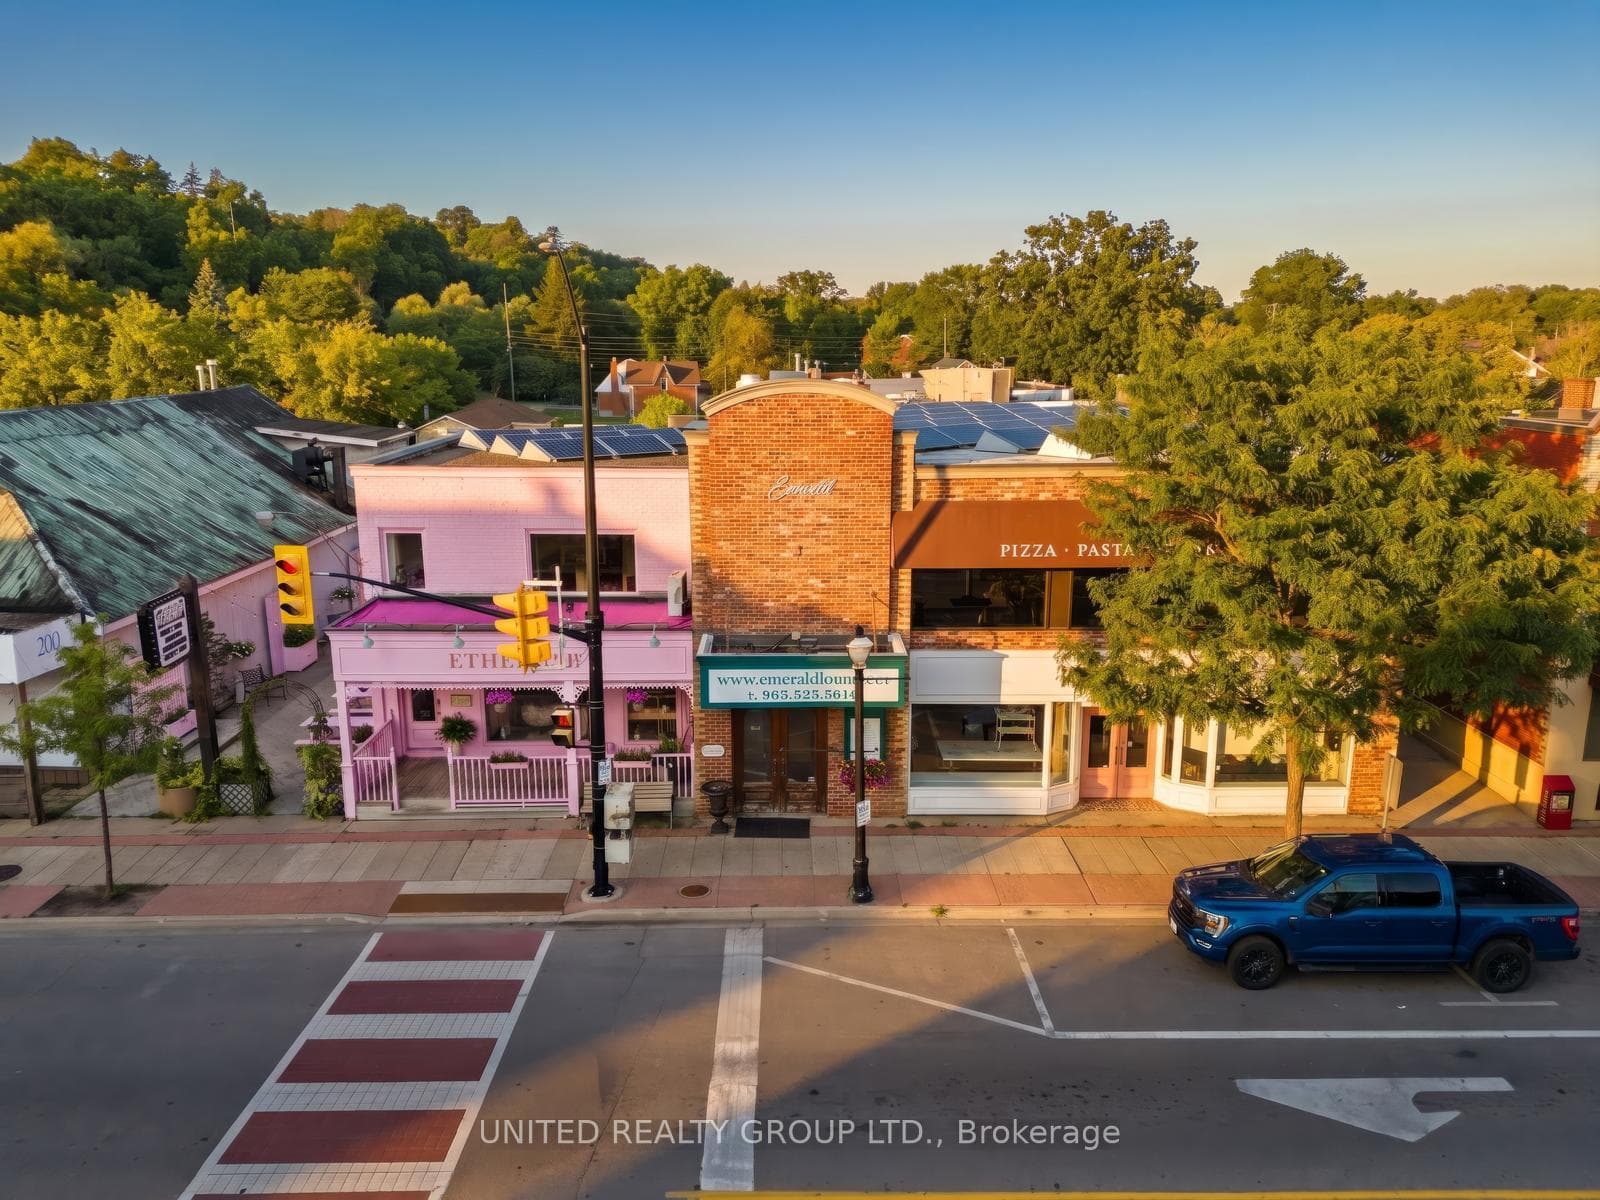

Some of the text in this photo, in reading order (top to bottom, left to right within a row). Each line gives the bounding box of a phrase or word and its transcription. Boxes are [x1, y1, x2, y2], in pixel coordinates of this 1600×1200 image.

[1000, 544, 1136, 557] PIZZA PASTA
[37, 631, 61, 657] 200
